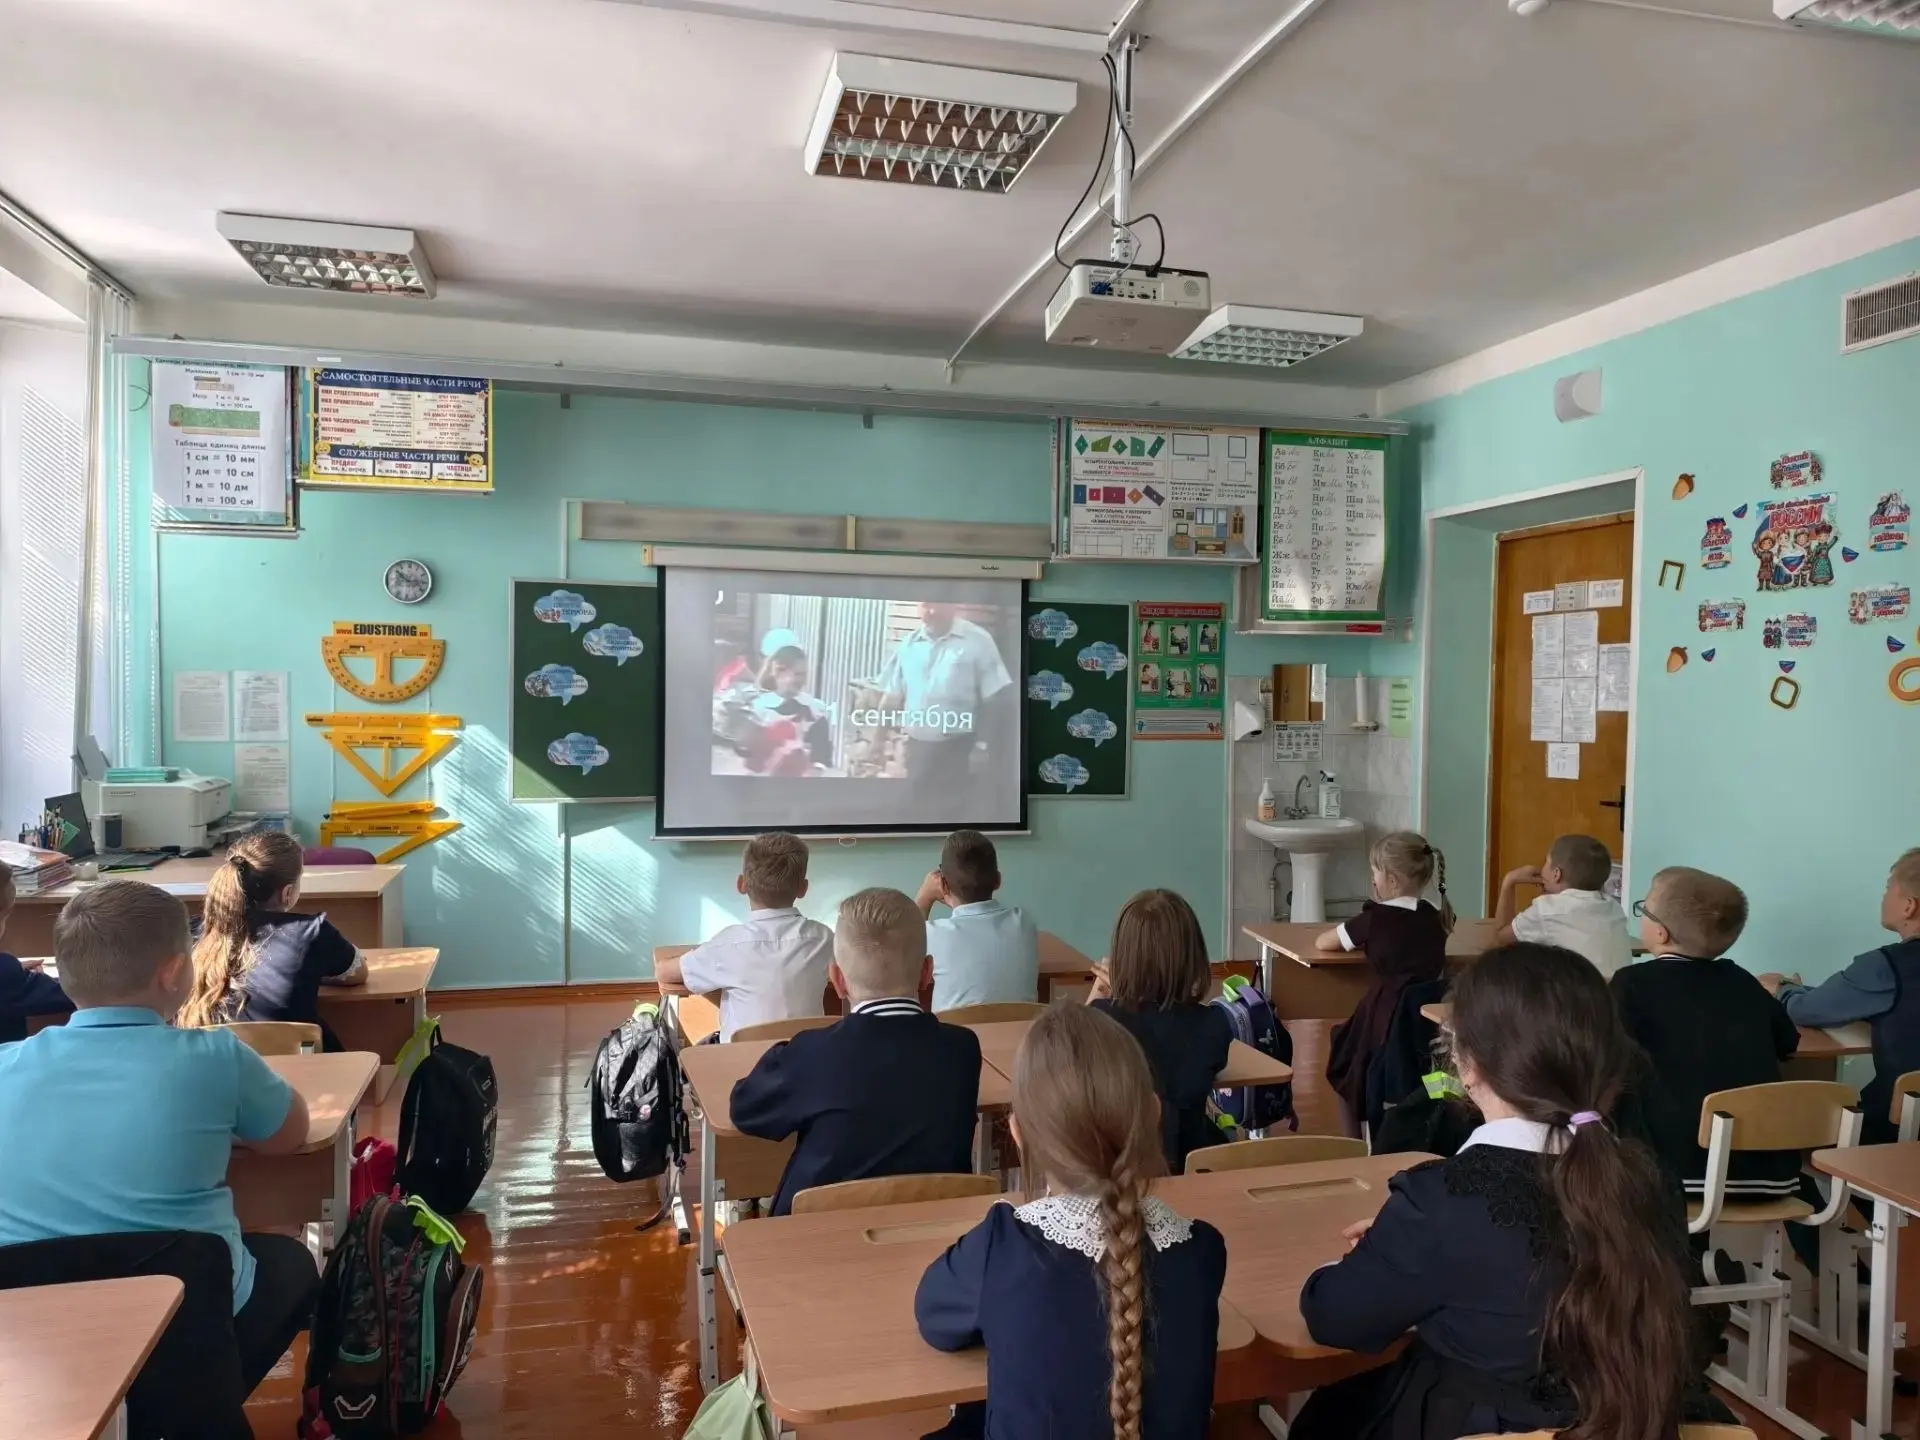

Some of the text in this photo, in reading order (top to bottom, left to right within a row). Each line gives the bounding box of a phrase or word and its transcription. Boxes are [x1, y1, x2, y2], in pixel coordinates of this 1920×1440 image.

[321, 371, 482, 388] САМОСТОЯТЕЛЬНЫЕ ЧАСТИ РЕЧИ
[175, 440, 208, 448] Таблица
[241, 443, 266, 451] длины
[1307, 438, 1349, 447] АЛФАВИТ
[186, 452, 191, 460] 1
[225, 454, 237, 463] 10
[339, 449, 460, 461] СЛУЖЕБНЫЕ ЧАСТИ РЕЧИ
[195, 468, 210, 476] дм
[226, 468, 237, 477] 10
[186, 480, 191, 488] 1
[220, 482, 231, 491] 10
[234, 484, 248, 492] дм
[186, 494, 191, 502] 1
[219, 496, 236, 505] 100
[1770, 504, 1824, 529] РОССИИ
[353, 624, 417, 637] EDUSTRONG
[850, 704, 973, 734] сентября
